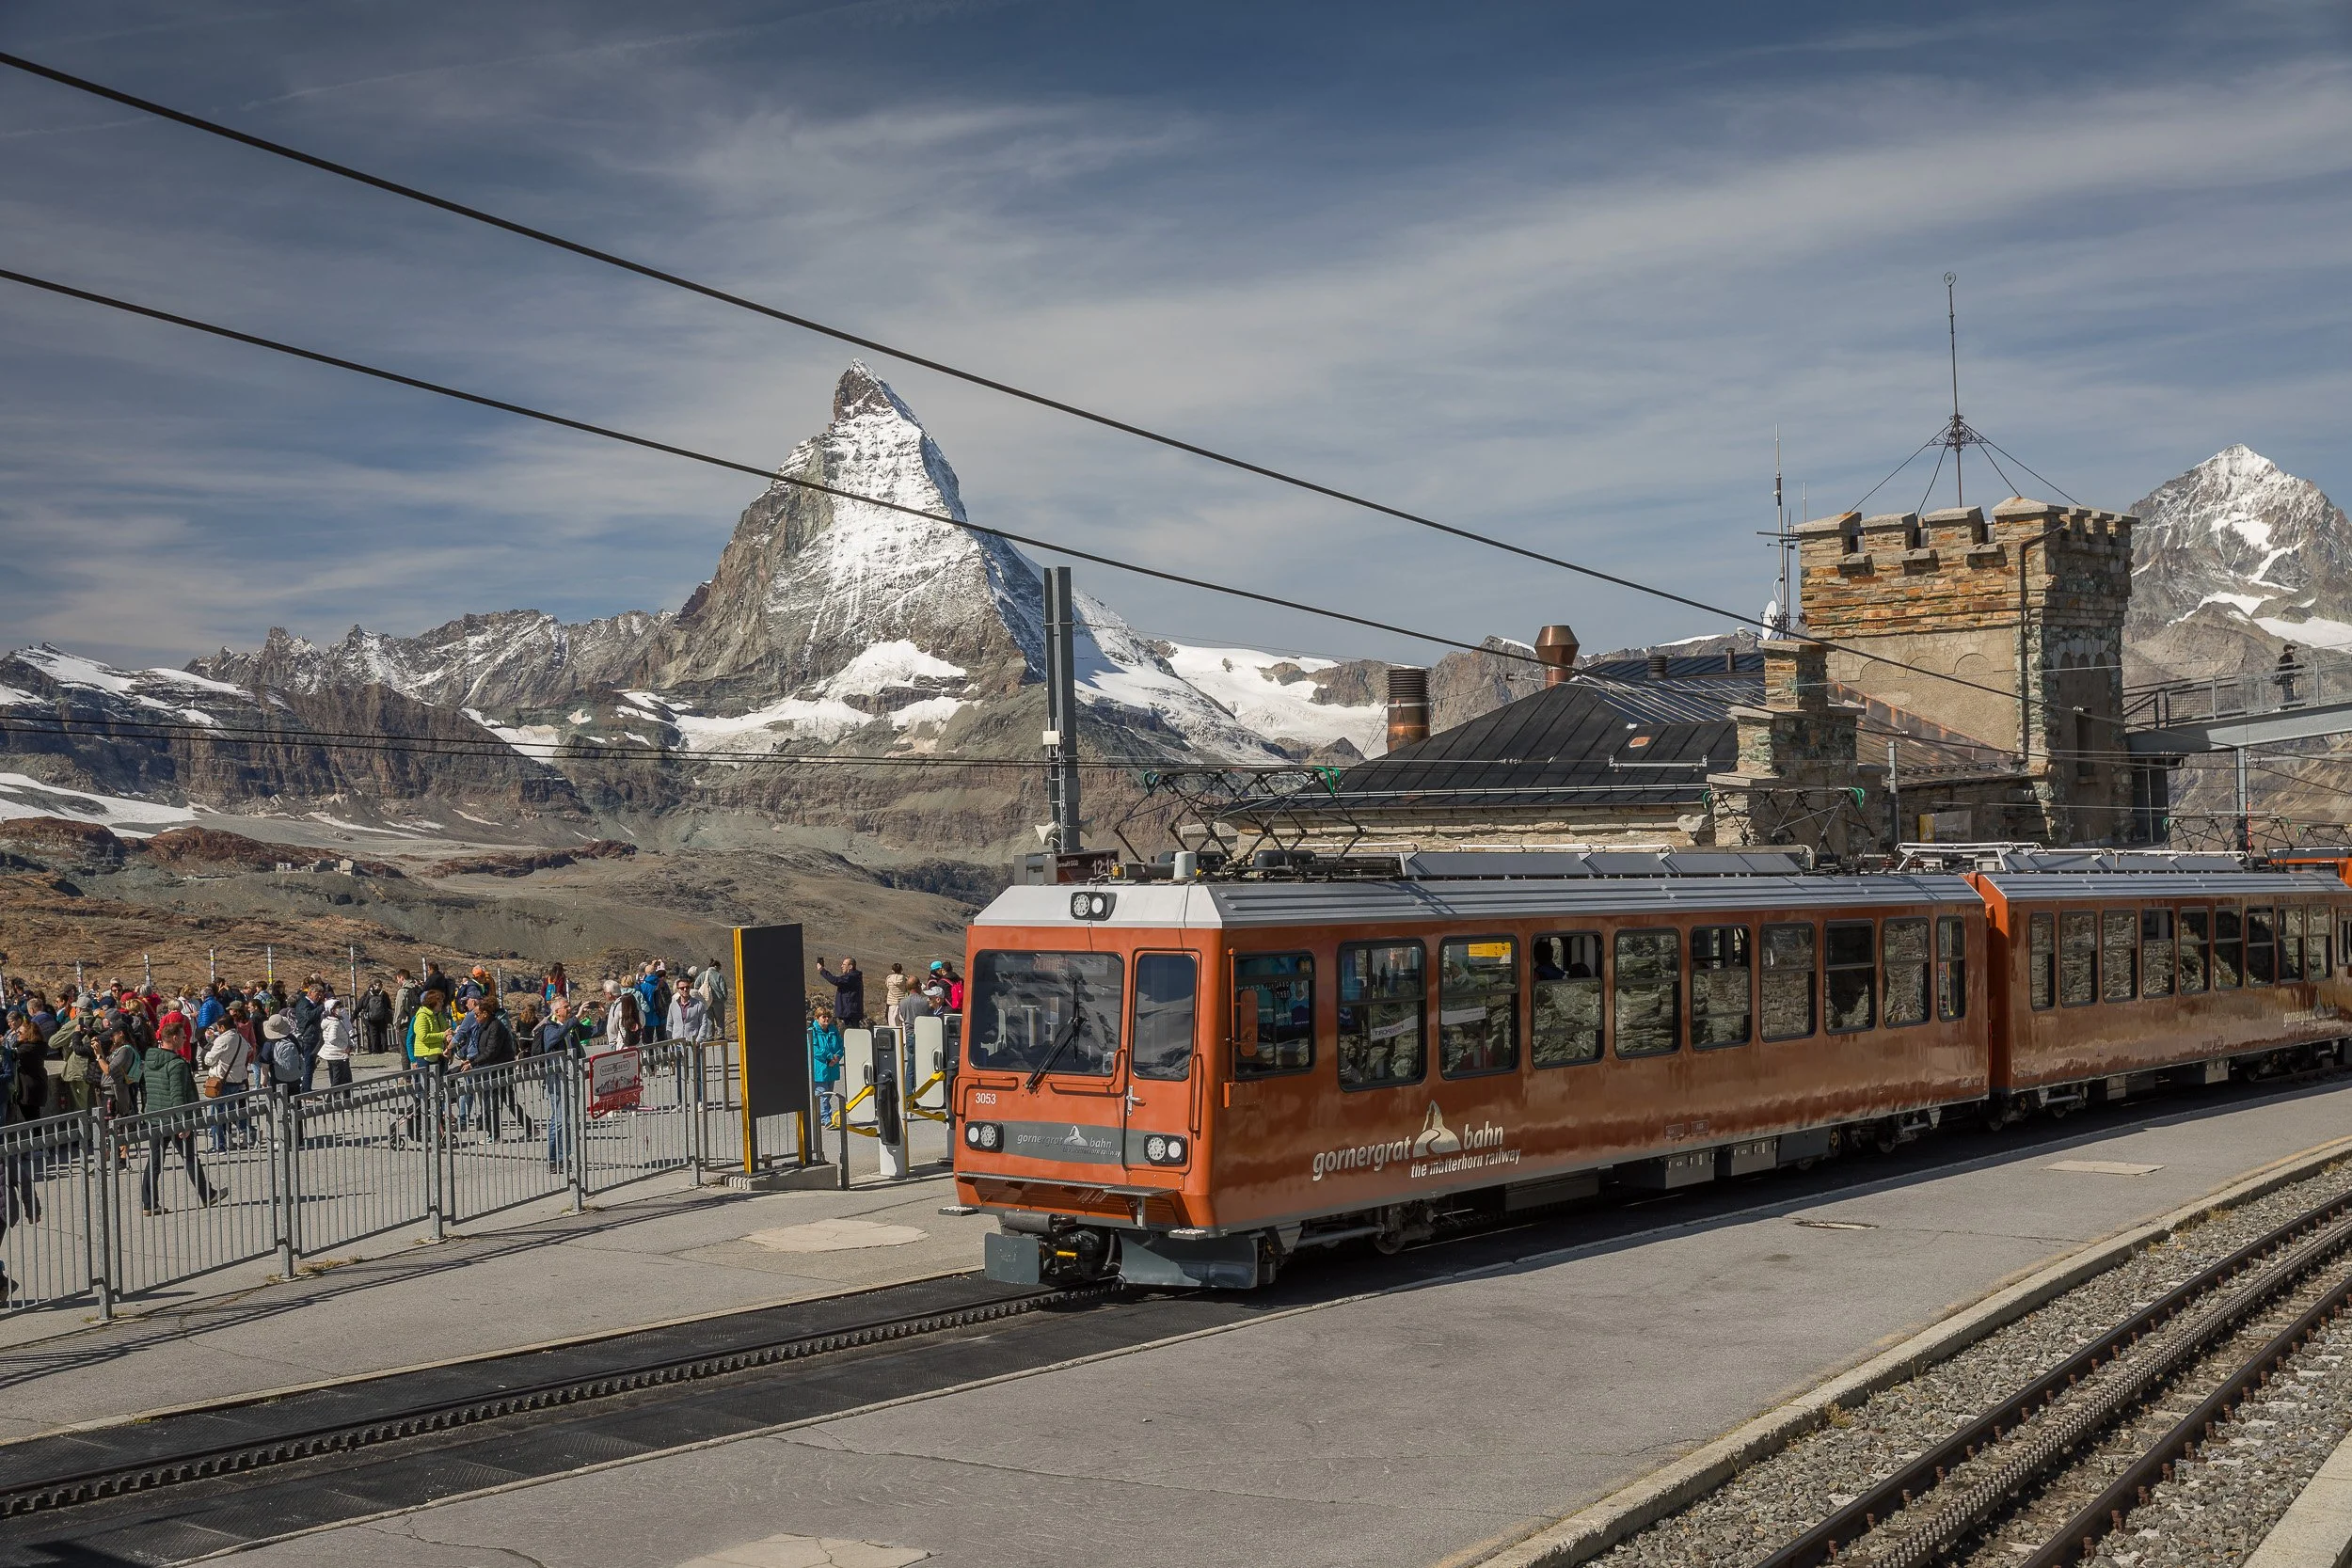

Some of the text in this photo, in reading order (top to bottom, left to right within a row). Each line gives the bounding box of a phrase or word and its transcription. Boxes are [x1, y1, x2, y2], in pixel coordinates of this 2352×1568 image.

[975, 1092, 996, 1105] 3053
[1017, 1133, 1112, 1148] gornergrat bahn
[1312, 1120, 1503, 1181] gornergrat bahn
[1410, 1148, 1521, 1179] the matterhorn railway
